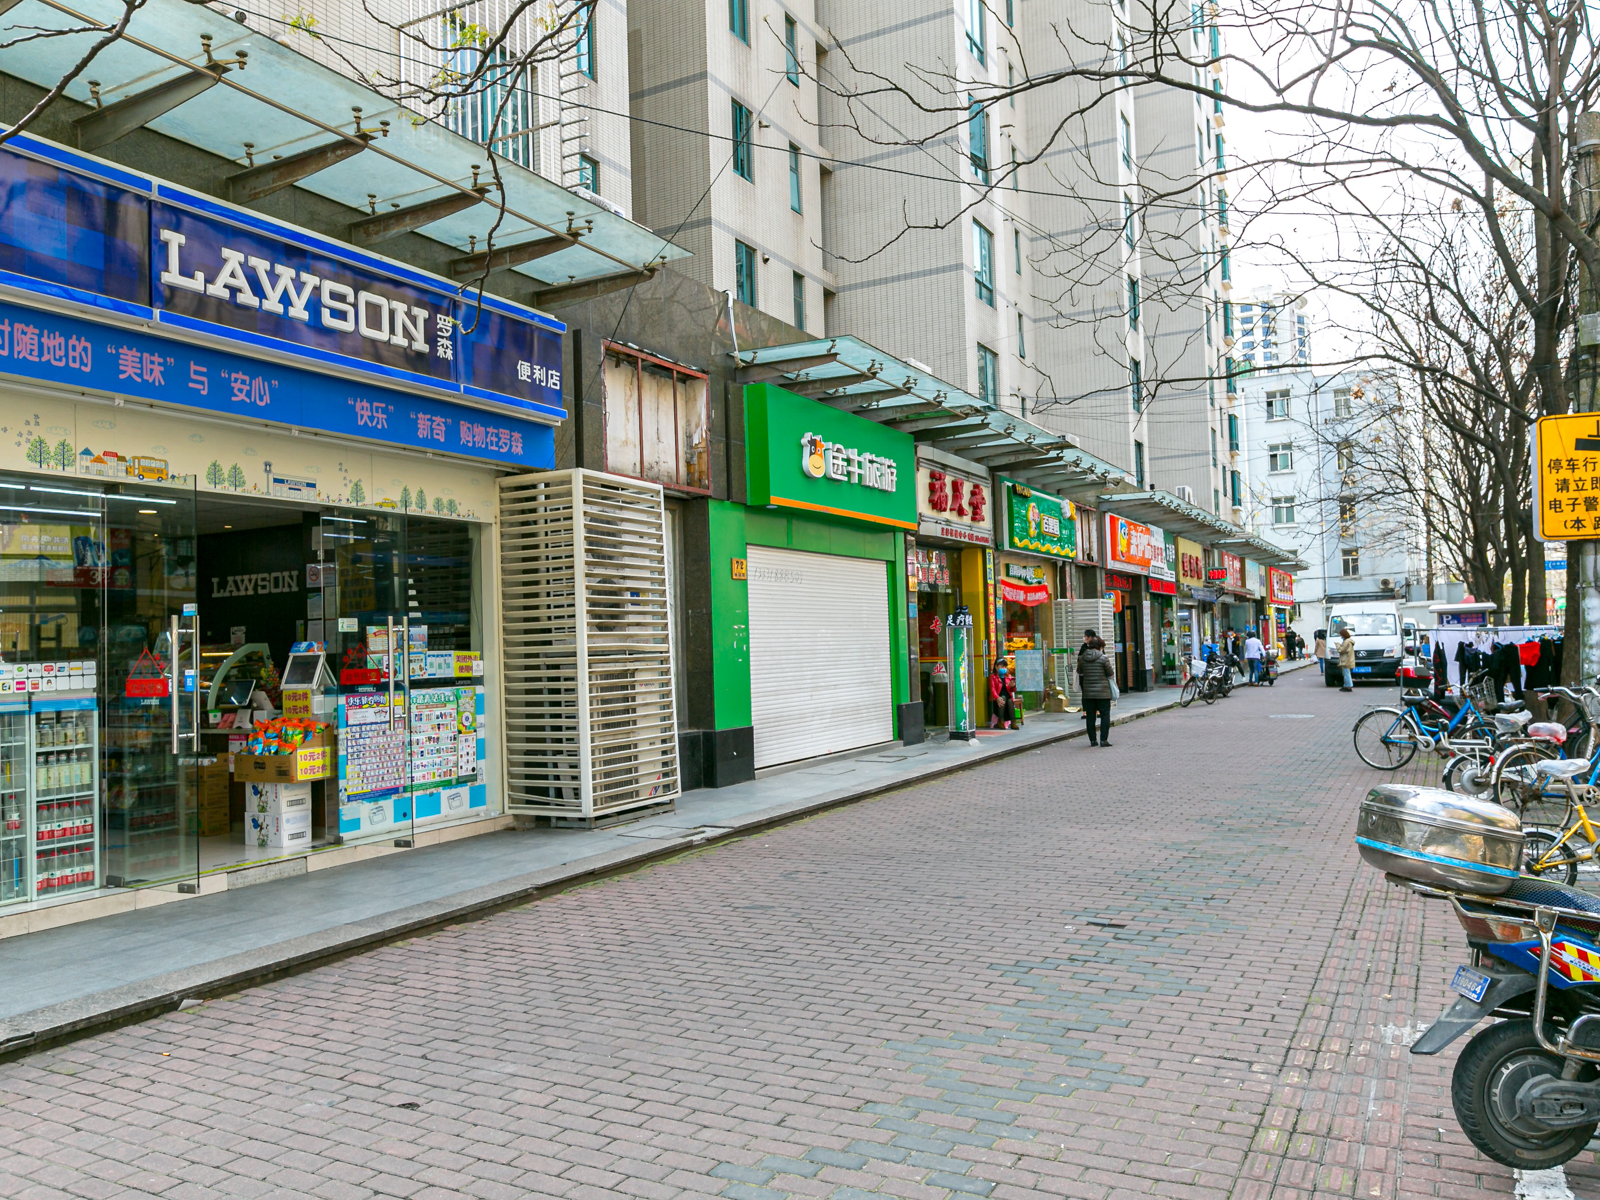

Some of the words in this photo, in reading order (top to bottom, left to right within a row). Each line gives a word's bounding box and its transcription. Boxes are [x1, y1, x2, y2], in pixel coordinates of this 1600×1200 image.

[160, 228, 430, 354] LAWSON
[436, 312, 454, 361] 罗森
[516, 359, 561, 390] 便利店
[188, 360, 208, 395] 与
[459, 420, 524, 456] 购物在罗森
[823, 441, 898, 493] 途牛旅游
[1547, 456, 1598, 474] 停车行
[1549, 495, 1599, 513] 电子警
[735, 561, 744, 570] 72
[211, 570, 300, 598] LAWSON
[1441, 614, 1452, 625] P
[284, 690, 309, 702] 10元2件
[284, 704, 310, 715] 10元2件
[299, 750, 328, 762] 10元2件
[299, 763, 328, 776] 10元2件
